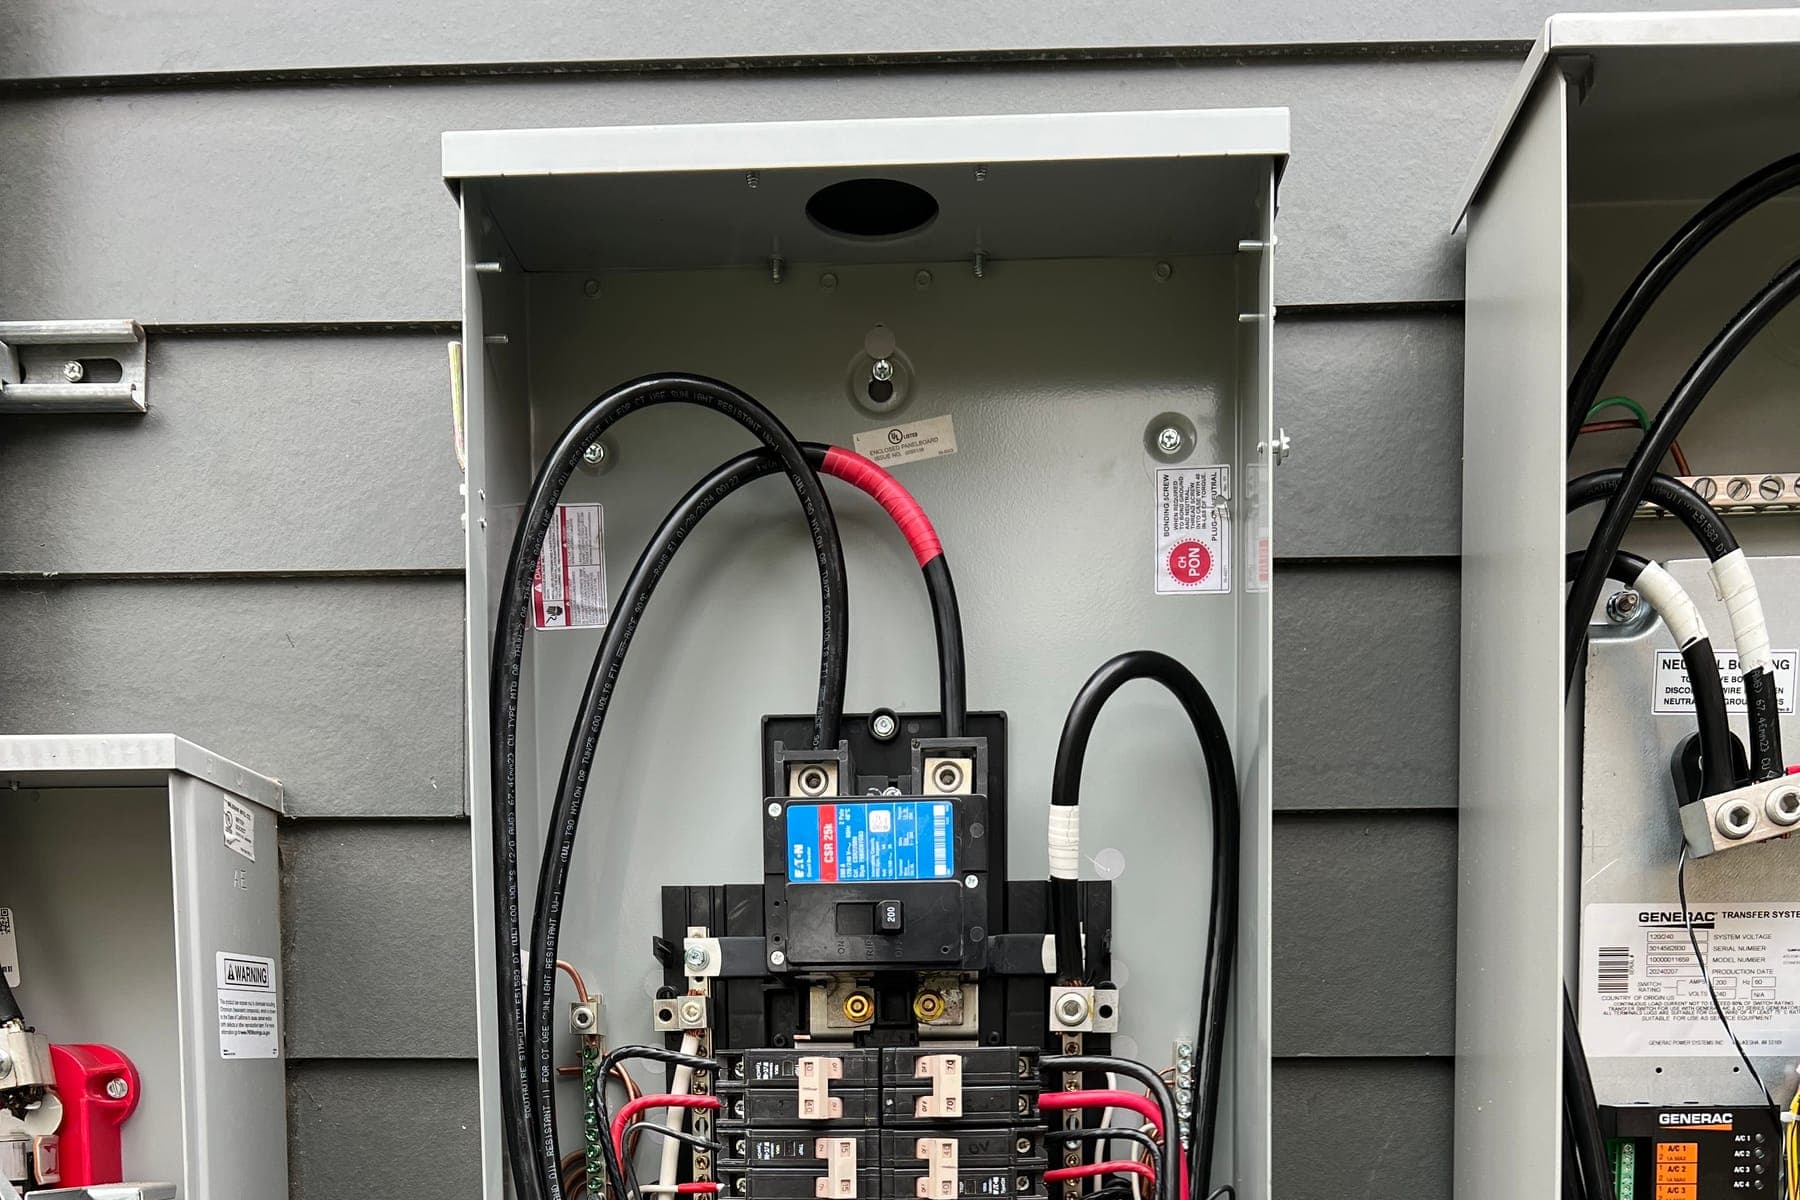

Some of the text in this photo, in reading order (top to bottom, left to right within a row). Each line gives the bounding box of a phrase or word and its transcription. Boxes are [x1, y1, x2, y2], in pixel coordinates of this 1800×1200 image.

[718, 400, 761, 432] RESISTANT
[869, 446, 900, 456] ENCLOSED
[901, 437, 939, 449] PANELBOARD
[1692, 511, 1718, 543] E51583
[1178, 556, 1187, 568] CH
[1188, 547, 1200, 577] PON
[520, 606, 528, 618] OR
[823, 605, 831, 623] 600
[511, 663, 520, 676] OR
[1662, 659, 1725, 671] NEUL
[597, 682, 612, 711] VOLTS
[1663, 698, 1697, 706] NEUTRA
[508, 705, 517, 729] TYPE
[591, 715, 601, 733] 600
[577, 769, 587, 782] OR
[570, 786, 583, 815] NYLON
[823, 823, 833, 863] CSR 25k
[509, 904, 517, 922] 600
[887, 906, 896, 923] 200
[1638, 911, 1800, 923] GENERAC TRANSFER SYSTE
[545, 918, 557, 969] RESISTANT
[234, 964, 267, 984] WARNING
[541, 1025, 550, 1044] USE
[541, 1048, 550, 1060] CT
[541, 1064, 550, 1083] FOR
[520, 1065, 531, 1119] SOUTHWIRE
[946, 1100, 954, 1111] 70
[1659, 1113, 1733, 1124] GENERAC
[542, 1104, 553, 1157] RESISTANT
[548, 1168, 556, 1183] OIL
